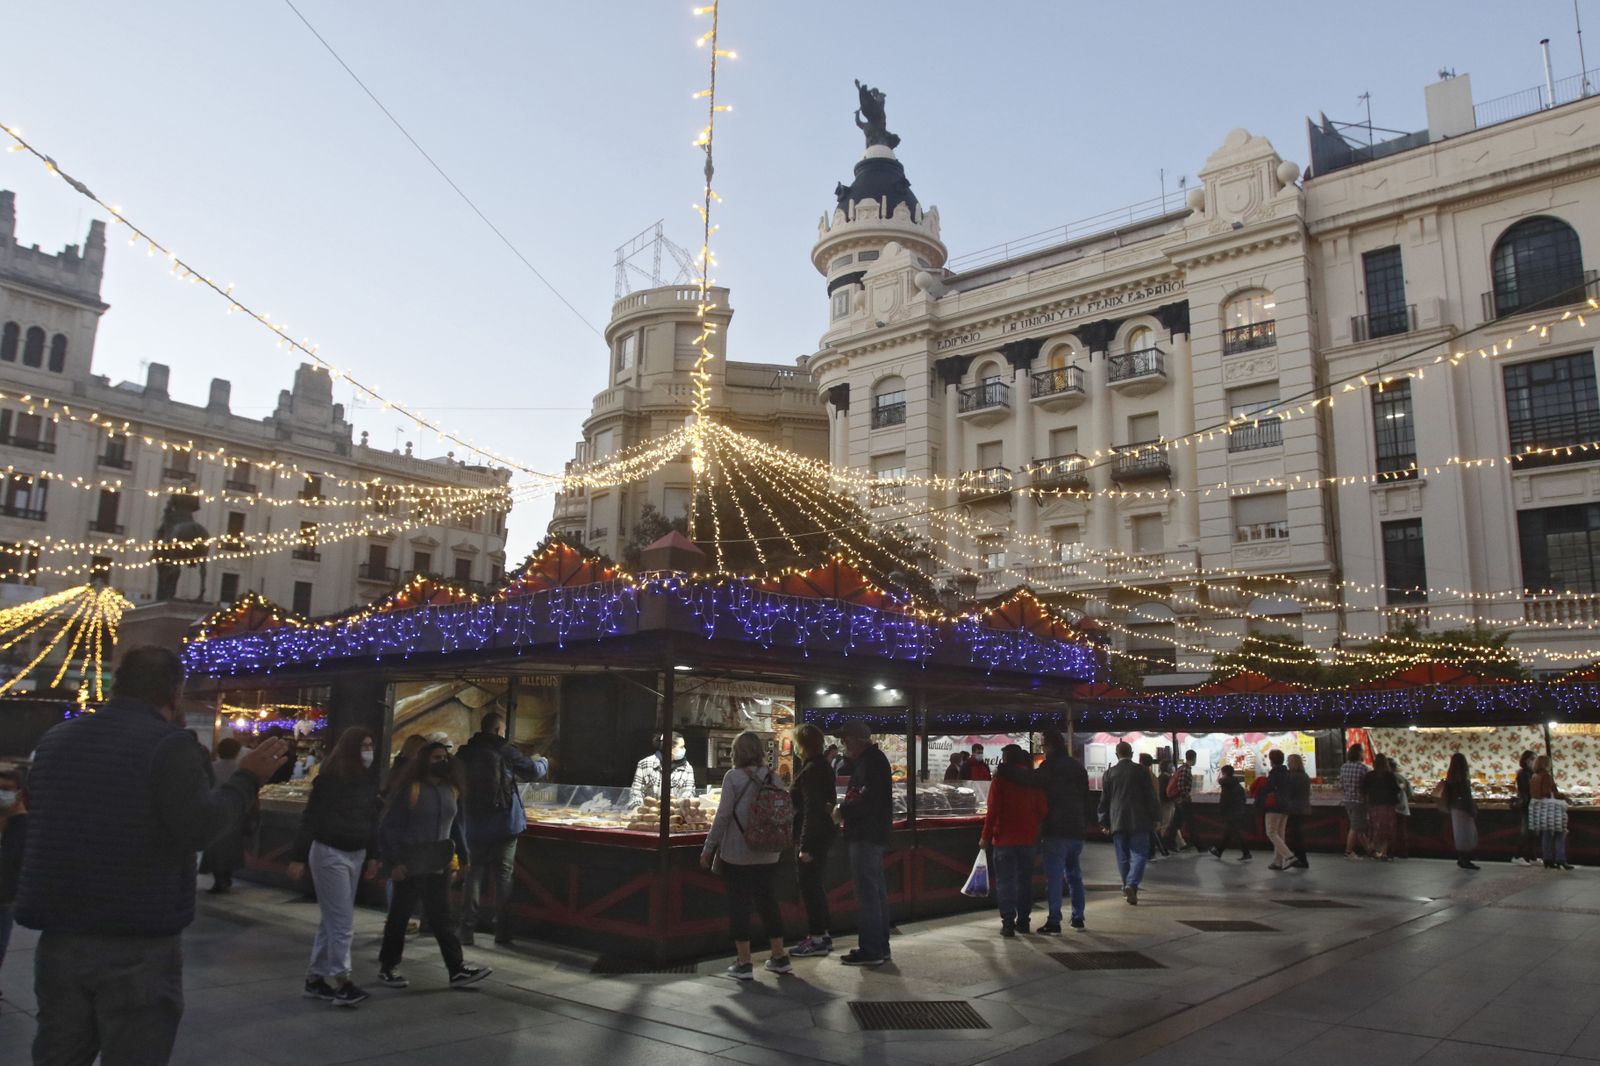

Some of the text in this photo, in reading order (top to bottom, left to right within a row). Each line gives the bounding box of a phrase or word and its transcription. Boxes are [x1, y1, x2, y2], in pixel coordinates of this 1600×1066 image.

[936, 332, 981, 351] EDIFICIO
[1002, 322, 1017, 335] LA
[1056, 310, 1066, 320] Y
[1068, 305, 1085, 318] EL
